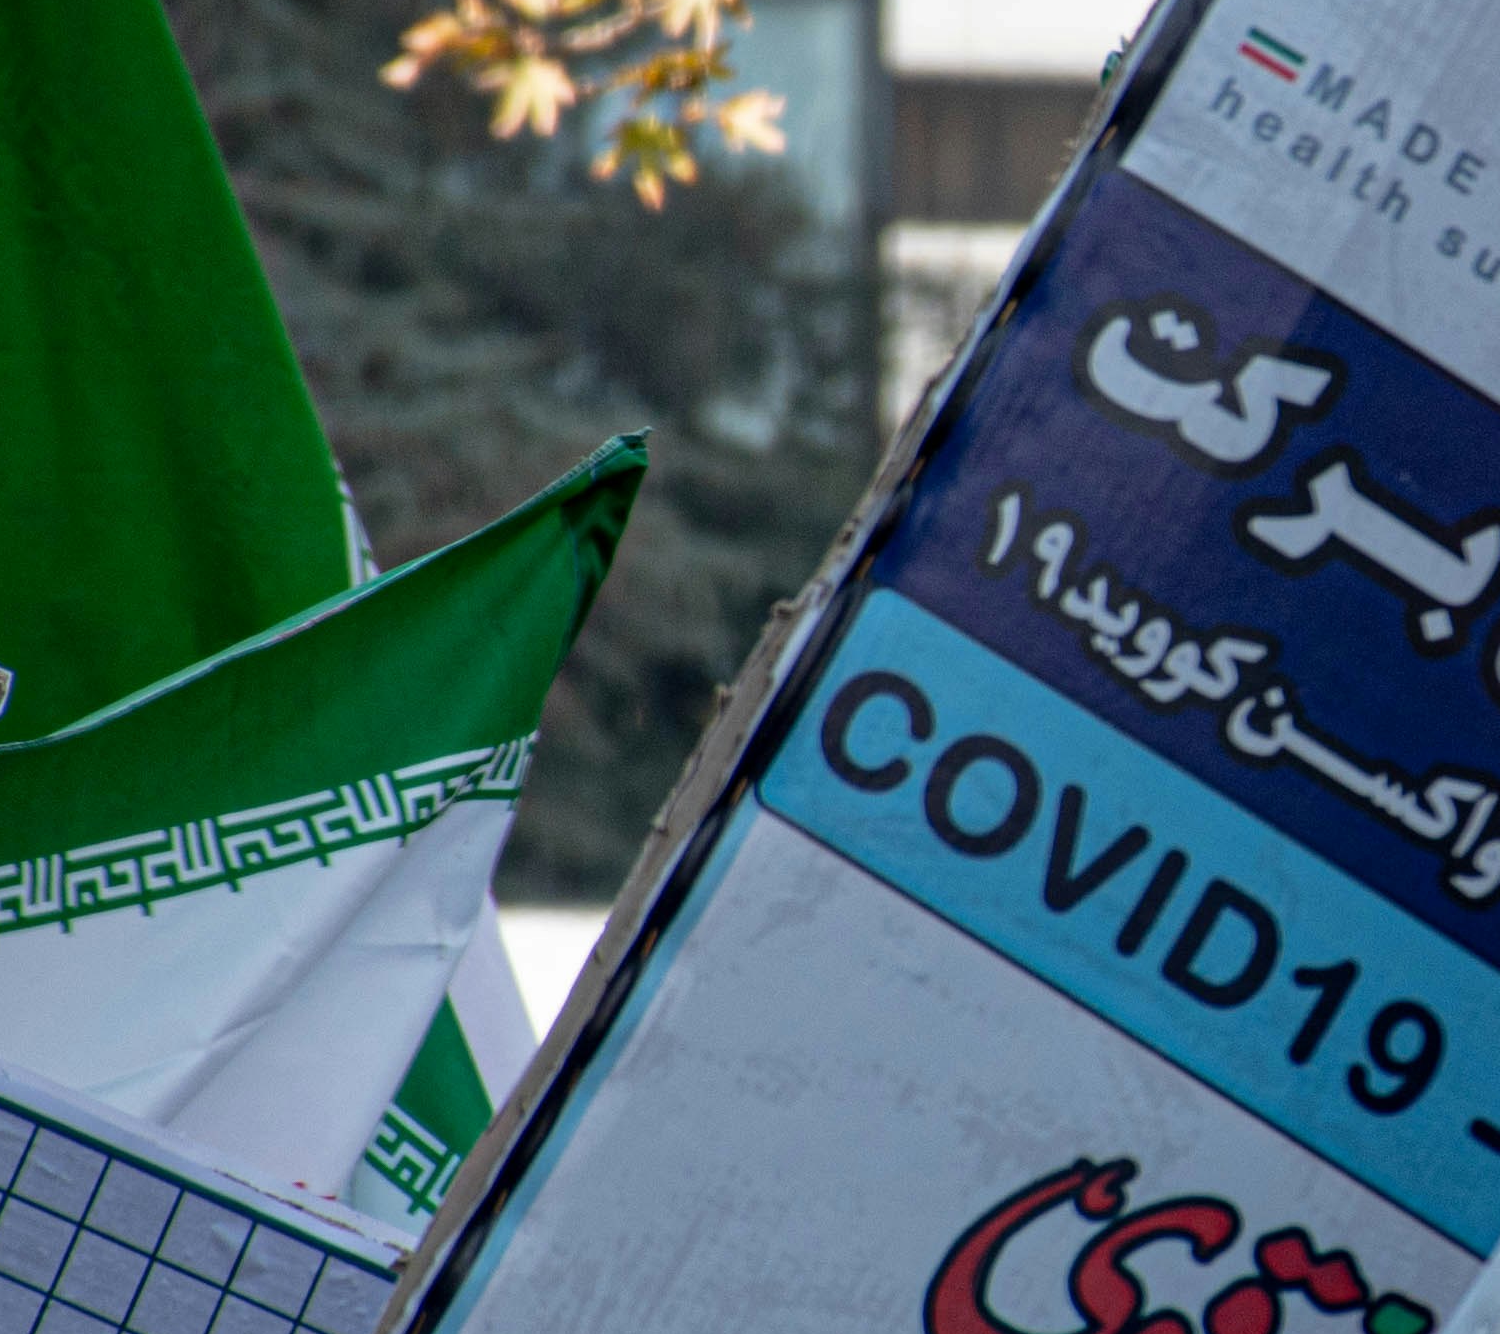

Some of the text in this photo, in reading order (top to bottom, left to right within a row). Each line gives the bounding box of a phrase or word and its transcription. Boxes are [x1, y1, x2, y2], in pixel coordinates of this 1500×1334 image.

[1209, 77, 1416, 227] health
[1303, 64, 1488, 197] MADE
[818, 669, 1448, 1117] COVID19
